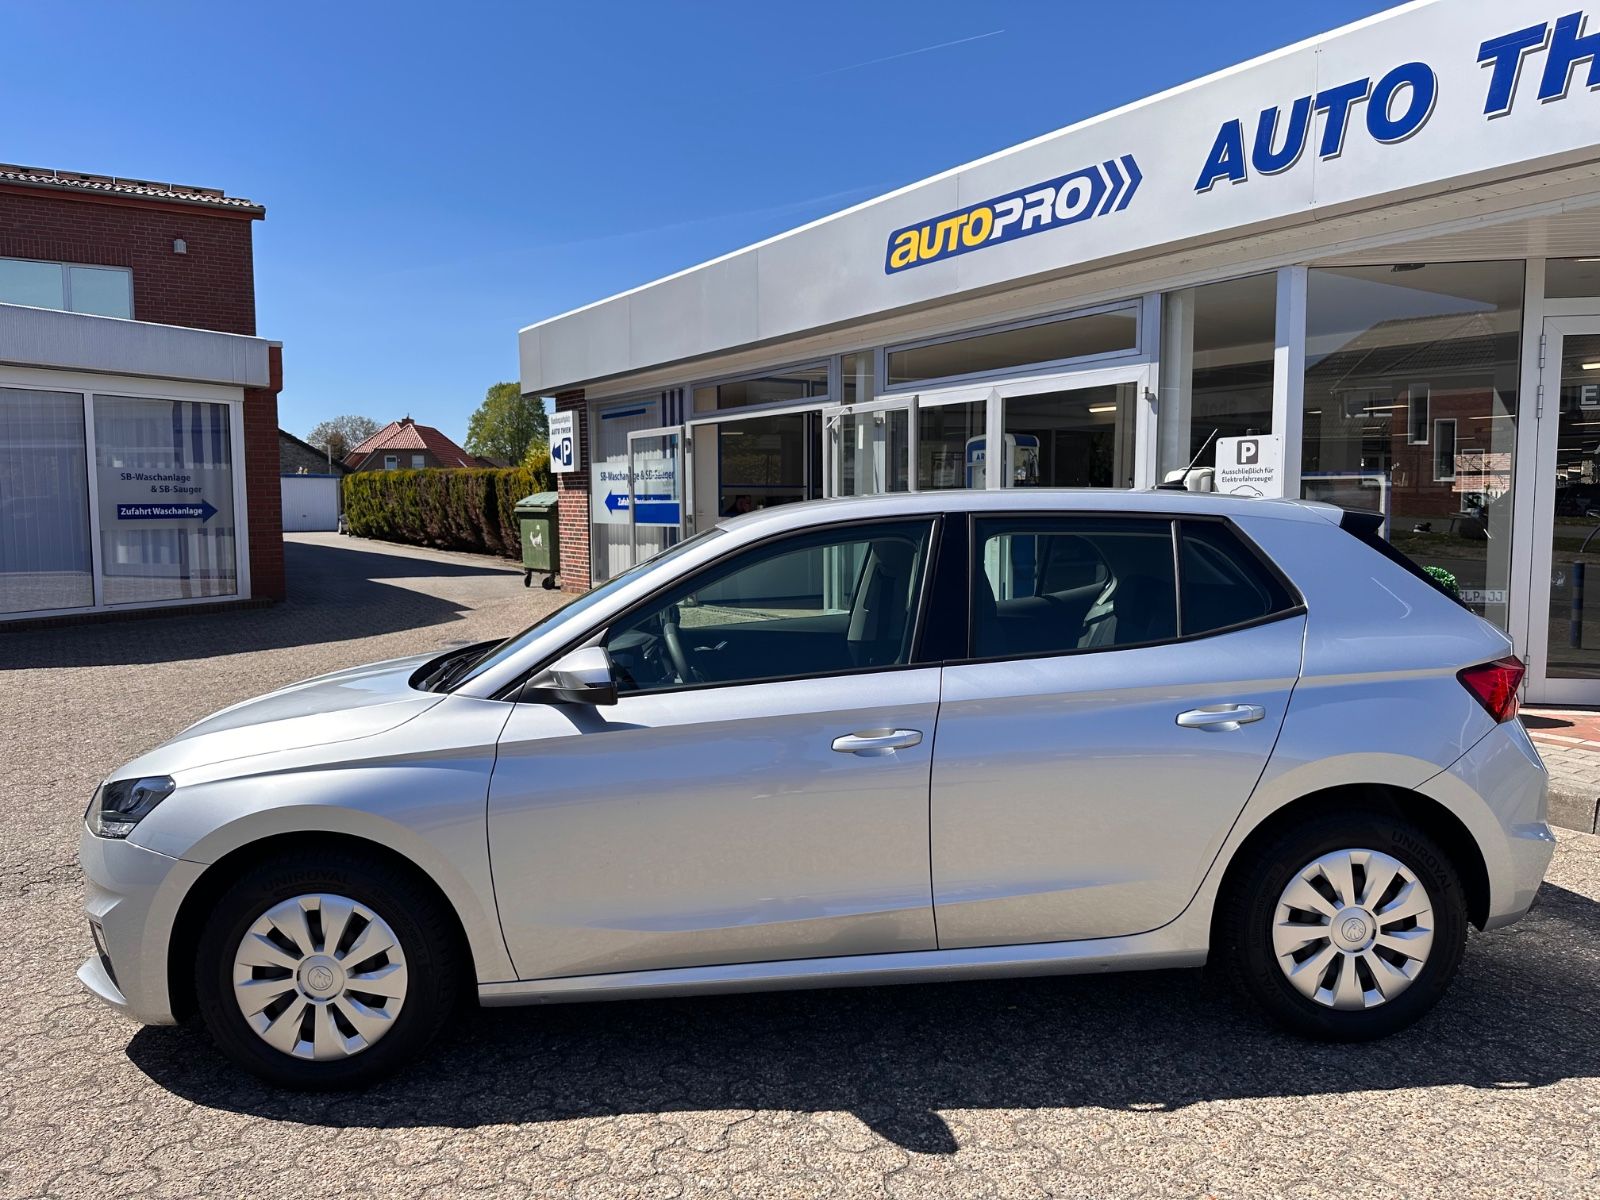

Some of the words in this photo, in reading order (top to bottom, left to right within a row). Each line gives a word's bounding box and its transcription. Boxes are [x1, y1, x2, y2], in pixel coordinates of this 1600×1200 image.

[1194, 61, 1438, 194] AUTO
[563, 439, 571, 464] P
[1241, 442, 1256, 463] P
[1221, 467, 1264, 475] Ausschließlich
[120, 472, 191, 483] SB-Waschanlage
[1221, 475, 1273, 483] Elektrofahrzeuge!
[150, 485, 157, 493] &
[159, 485, 202, 494] SB-Sauger
[120, 507, 151, 516] Zufahrt
[152, 506, 203, 516] Waschanlage
